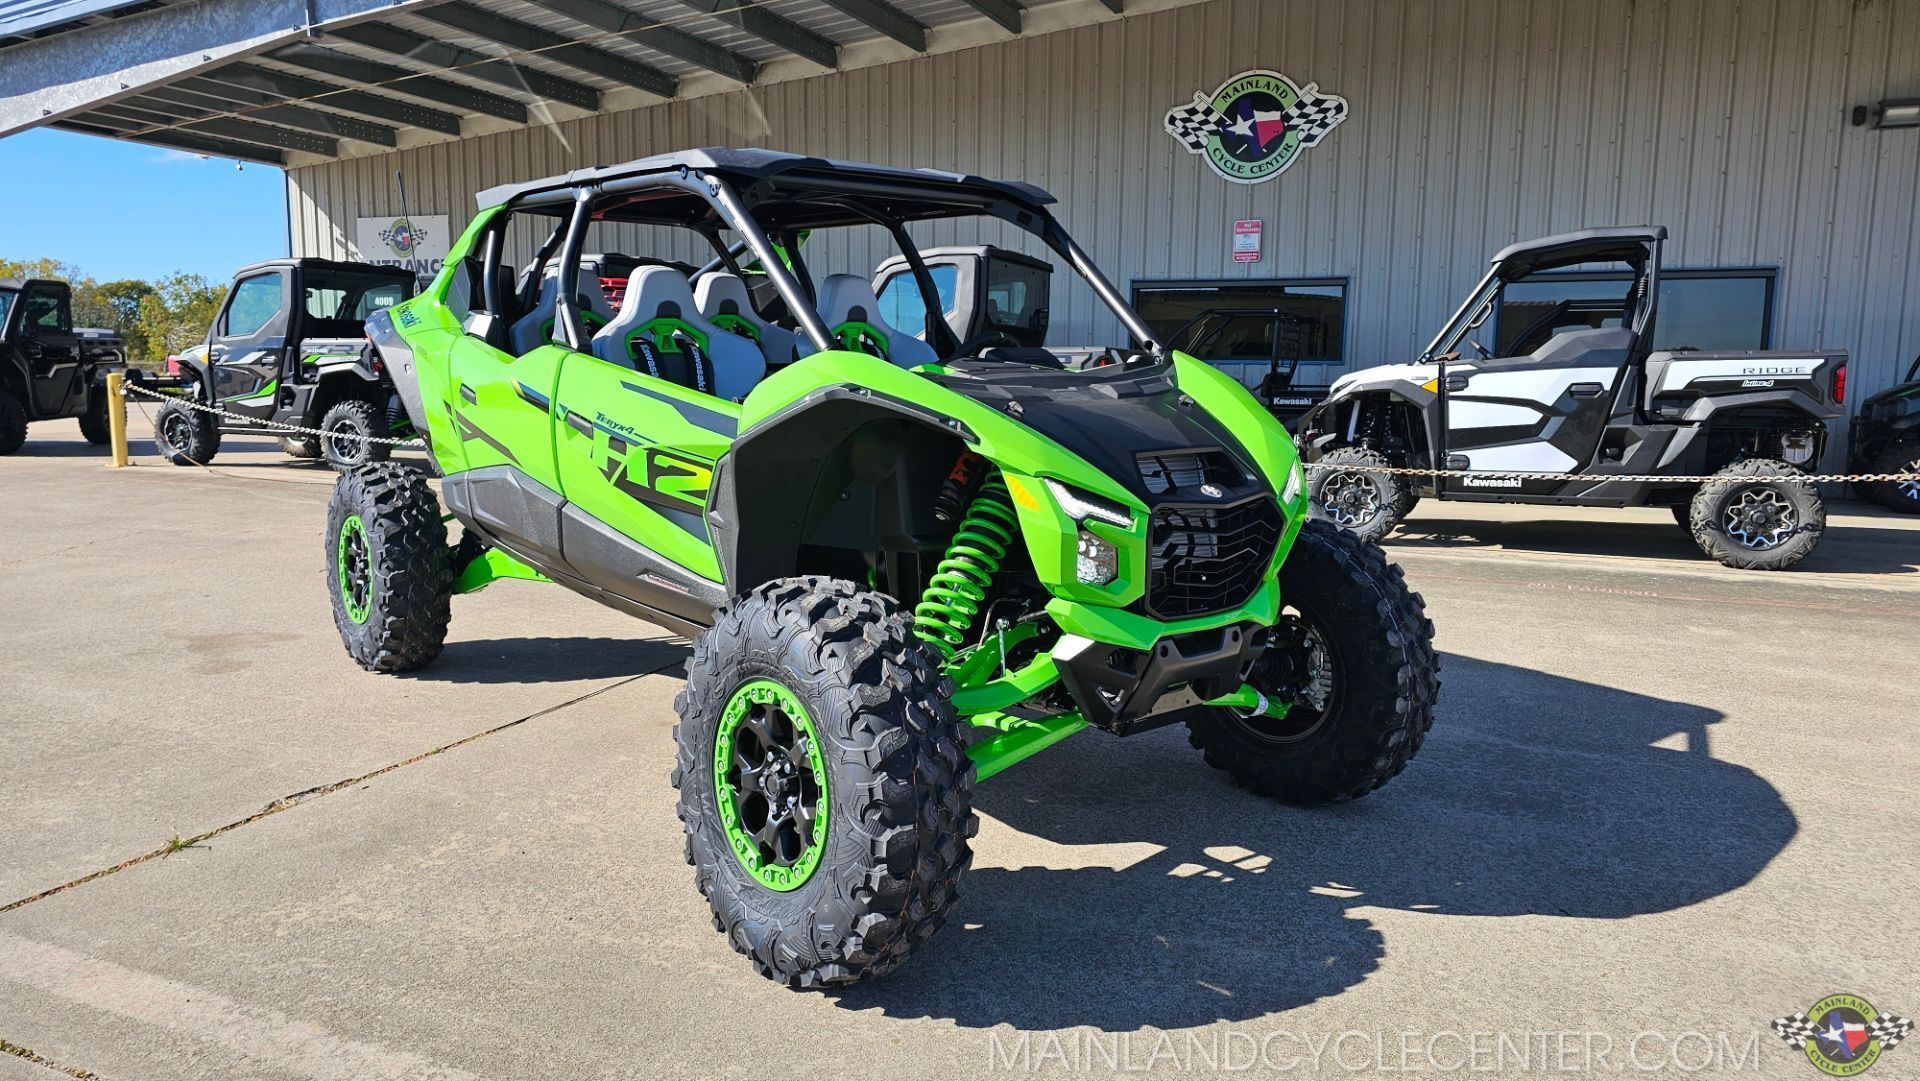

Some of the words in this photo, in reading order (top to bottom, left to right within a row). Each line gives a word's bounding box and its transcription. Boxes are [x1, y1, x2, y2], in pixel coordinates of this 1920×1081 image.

[1221, 80, 1289, 103] MAINLAND
[1213, 147, 1245, 174] CYCLE
[1249, 142, 1294, 174] CENTER
[1273, 397, 1312, 405] Kawasaki
[1463, 477, 1522, 488] Kawasaki
